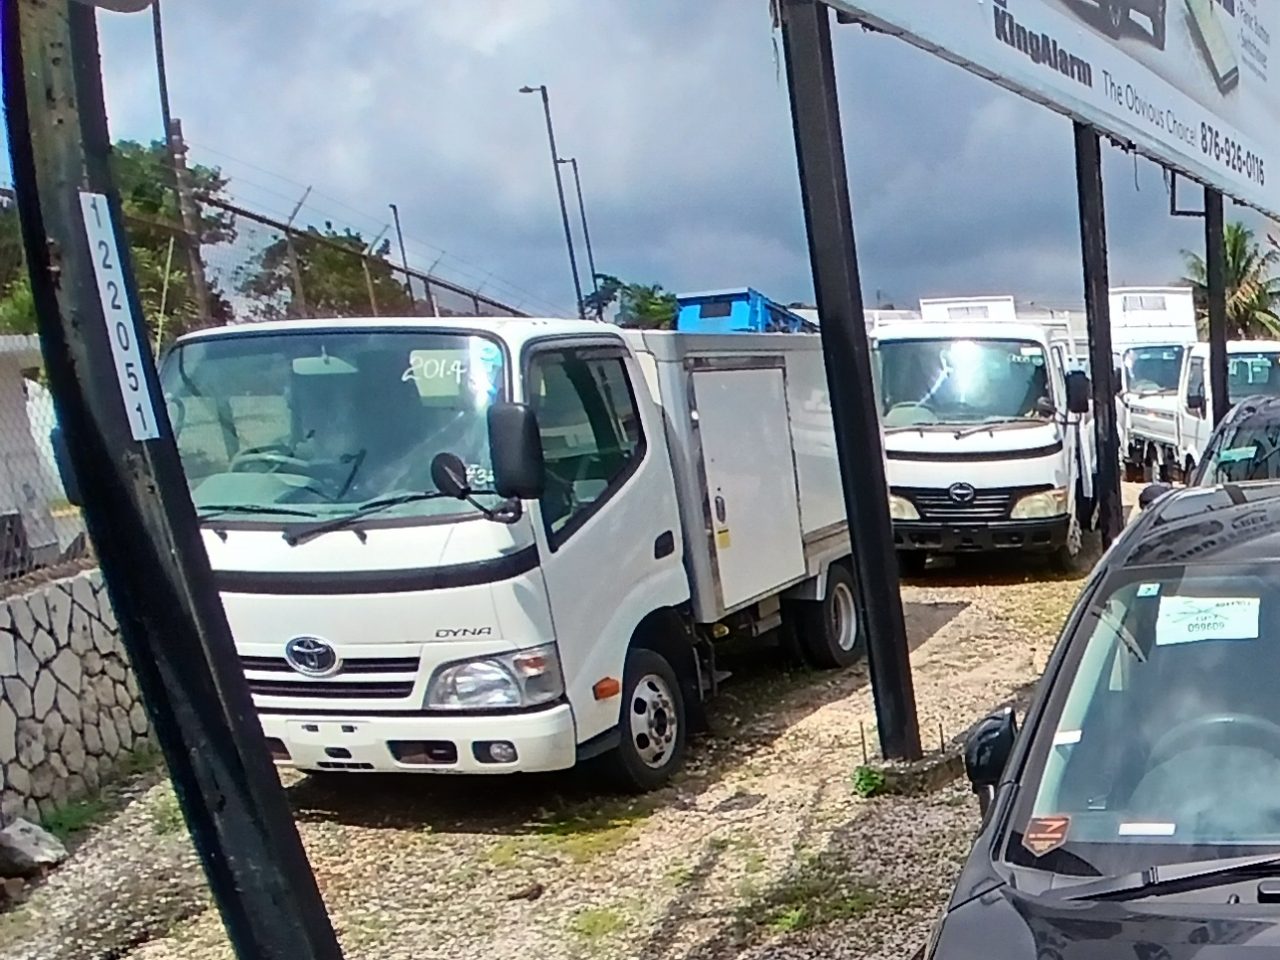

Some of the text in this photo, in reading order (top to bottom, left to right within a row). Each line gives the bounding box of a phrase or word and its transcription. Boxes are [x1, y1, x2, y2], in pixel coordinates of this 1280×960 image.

[993, 5, 1092, 88] KingAlarm
[1102, 69, 1123, 105] The
[1125, 84, 1164, 129] Obvious
[1200, 121, 1265, 186] 876-926-0116
[435, 626, 492, 638] DYNA
